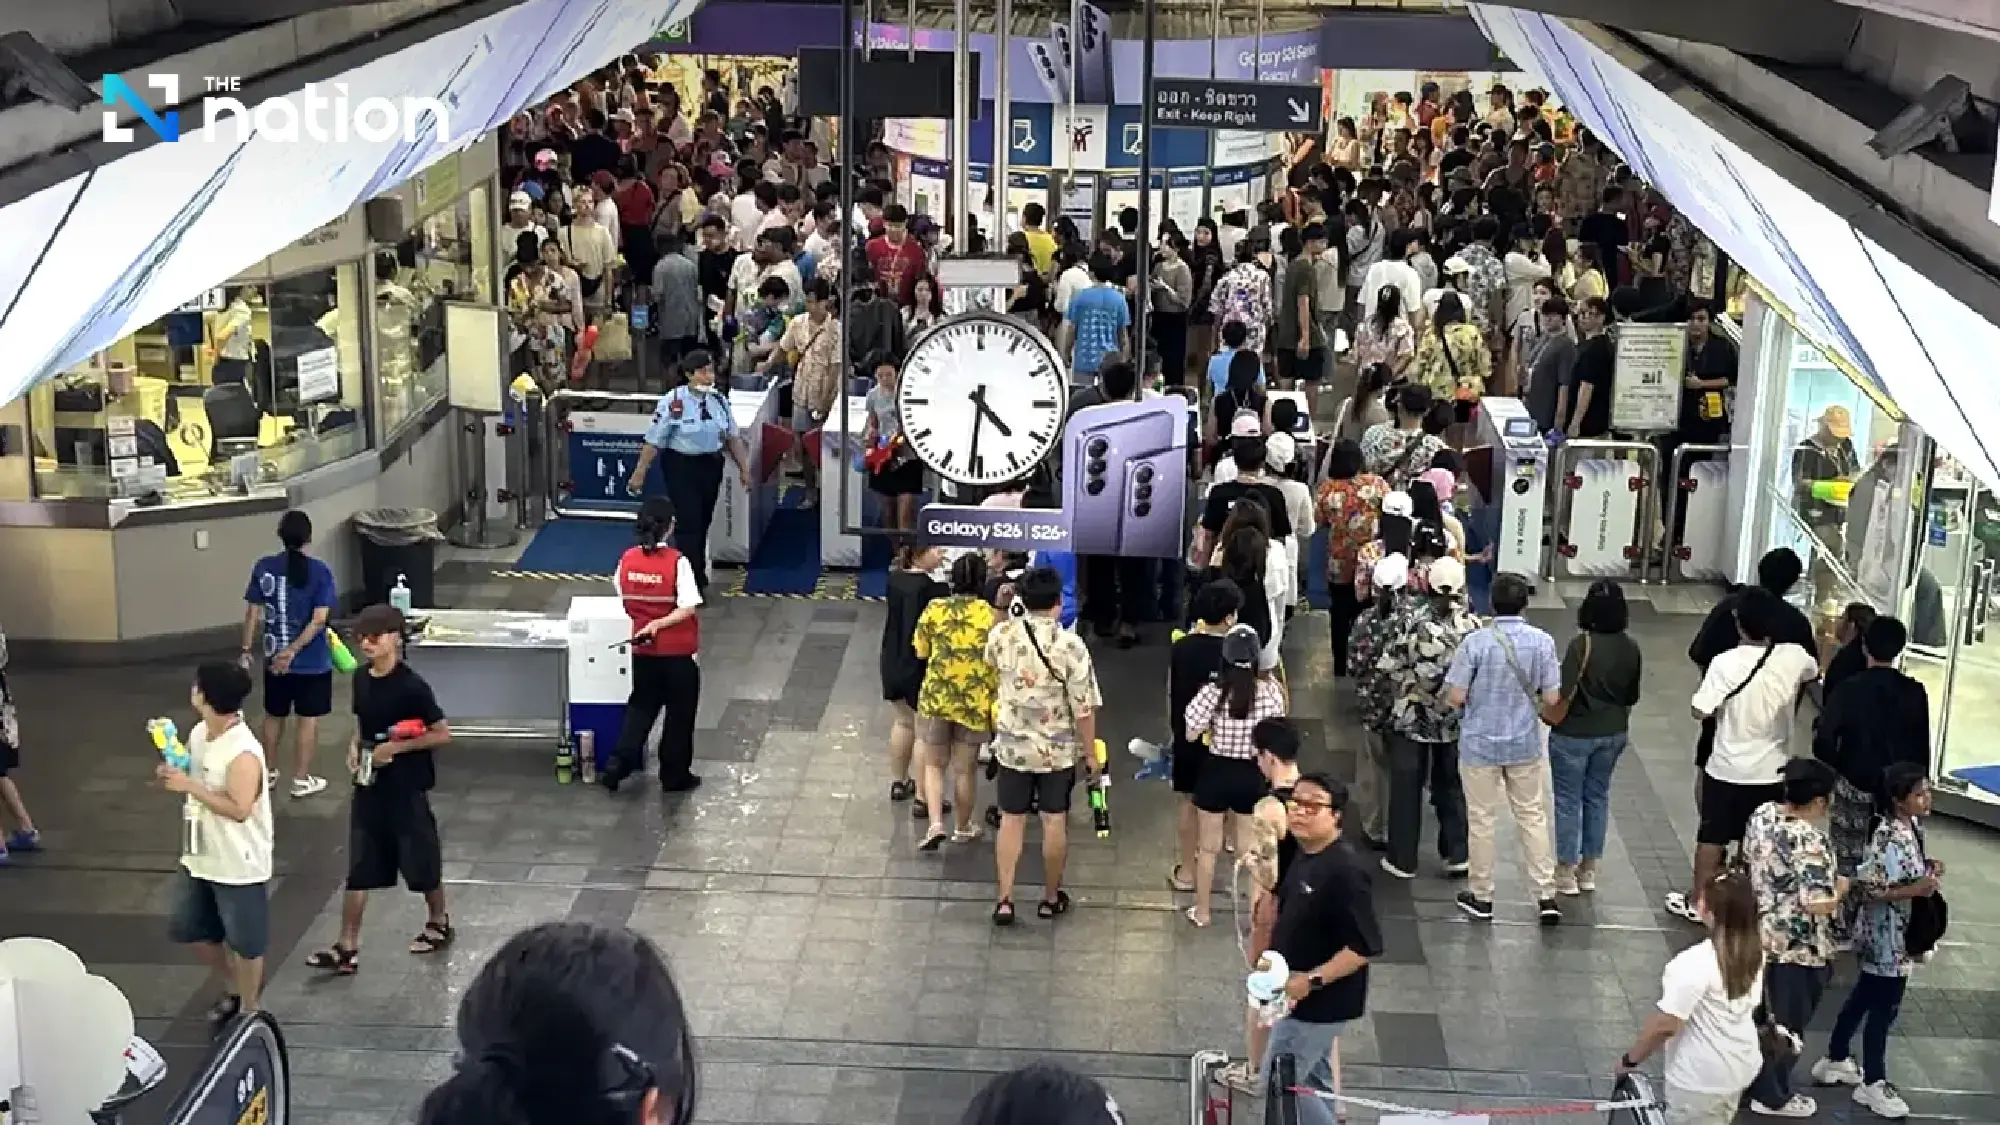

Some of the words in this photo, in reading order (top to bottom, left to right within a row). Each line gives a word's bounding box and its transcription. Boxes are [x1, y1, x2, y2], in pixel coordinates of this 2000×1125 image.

[1157, 90, 1190, 104] ออก
[1157, 107, 1181, 120] Exit
[1191, 109, 1222, 123] Keep
[1224, 111, 1257, 126] Right
[928, 519, 990, 541] Galaxy
[992, 522, 1023, 538] S26
[1031, 524, 1069, 540] S26+
[627, 570, 663, 583] SERVICE
